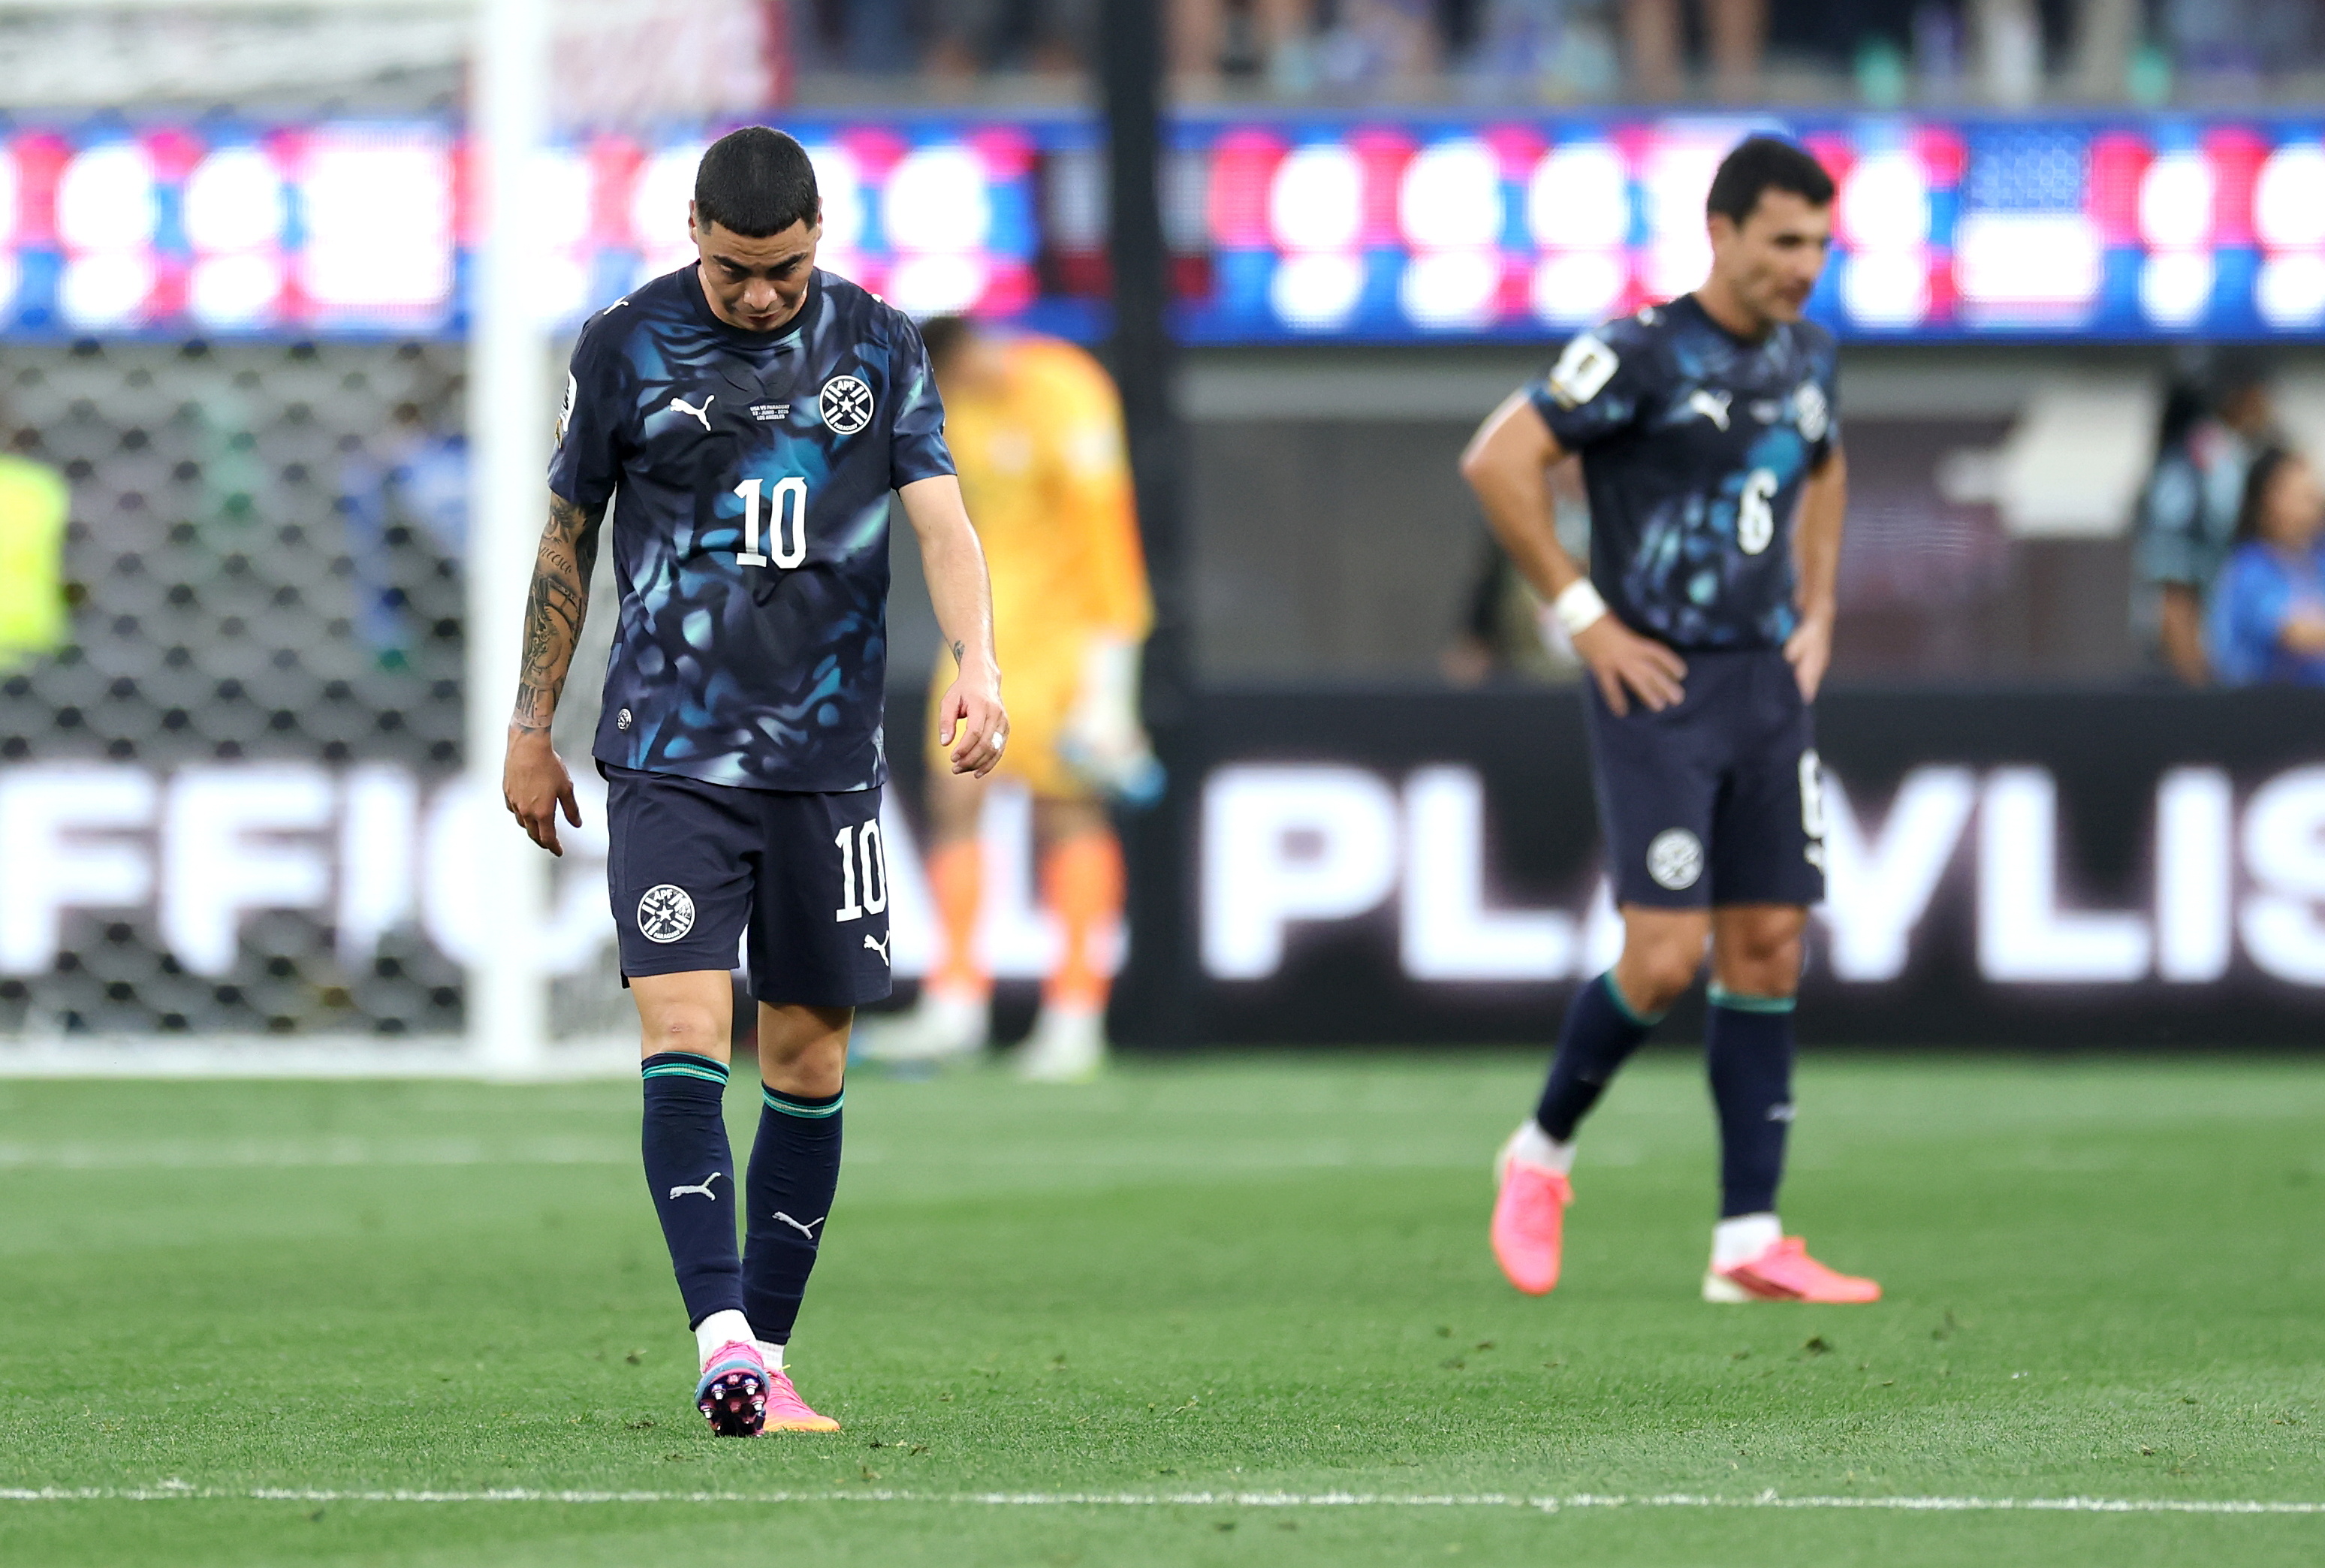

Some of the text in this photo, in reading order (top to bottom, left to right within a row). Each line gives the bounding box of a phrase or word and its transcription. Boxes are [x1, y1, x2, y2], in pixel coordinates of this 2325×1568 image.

[837, 380, 855, 391] APF
[834, 421, 858, 431] PARAGUAY
[1737, 466, 1778, 556] 6
[734, 476, 807, 569] 10
[834, 818, 887, 922] 10
[653, 888, 673, 901] APF
[653, 930, 680, 939] PARAGUAY
